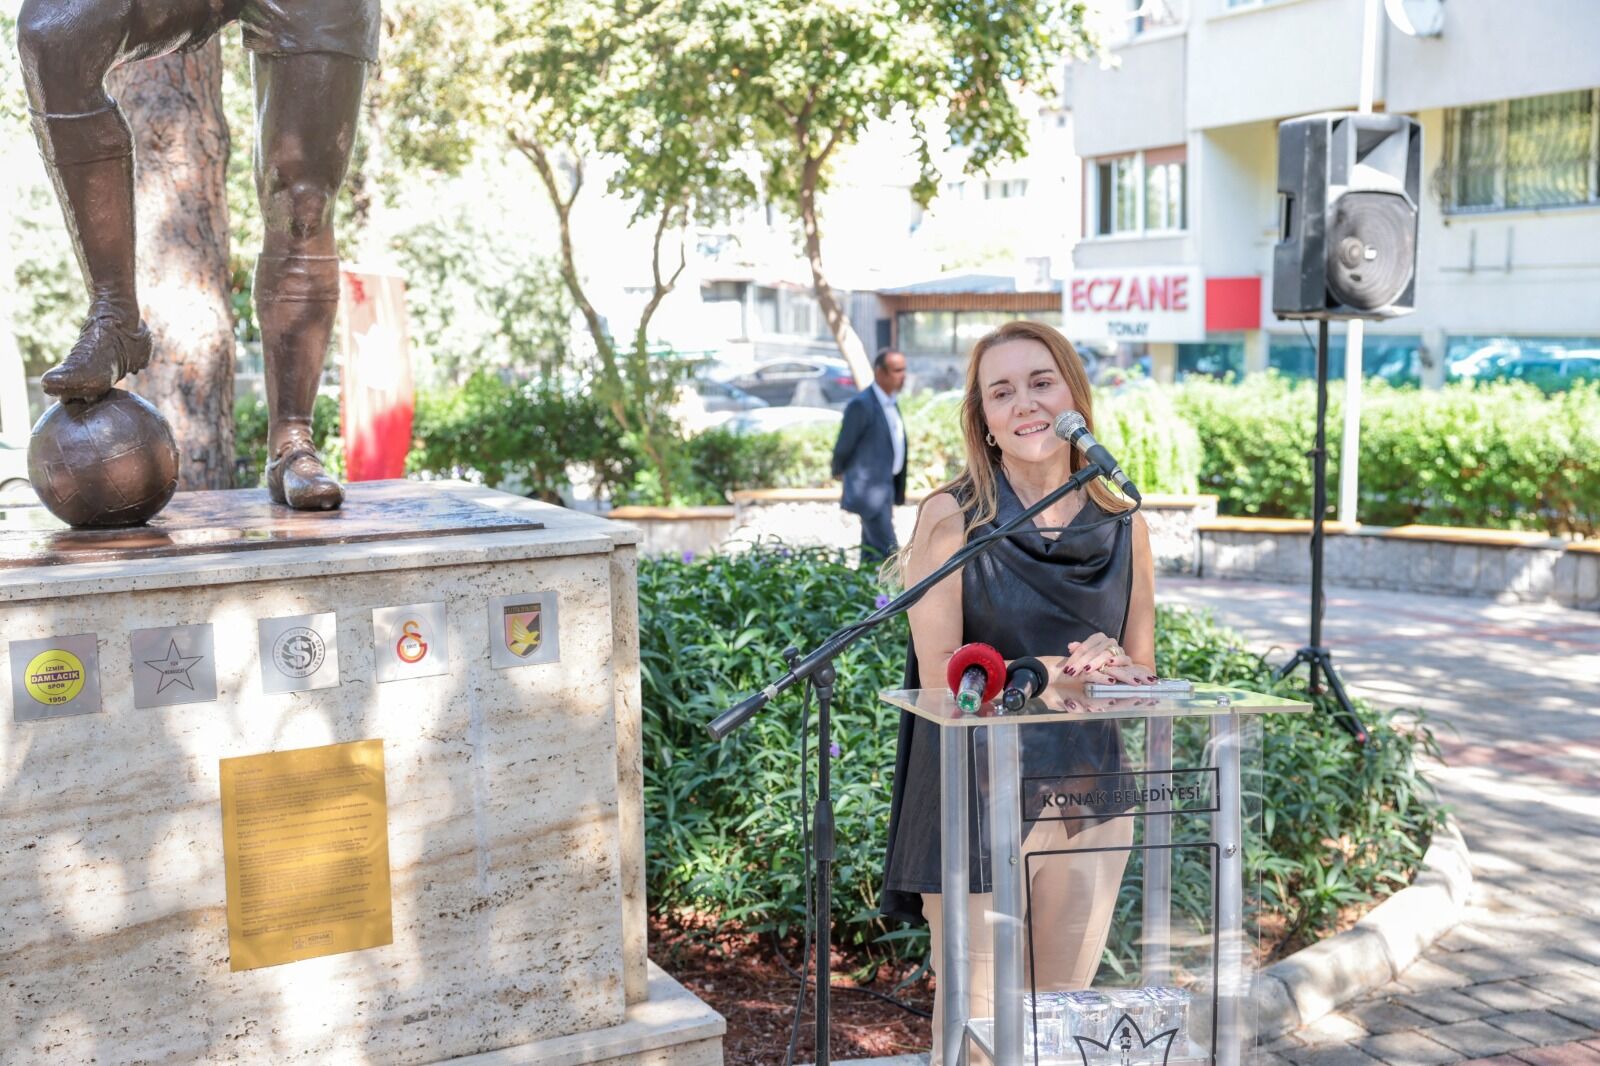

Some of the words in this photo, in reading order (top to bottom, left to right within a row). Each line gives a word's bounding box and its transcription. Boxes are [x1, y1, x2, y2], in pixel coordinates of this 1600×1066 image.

[1071, 275, 1188, 312] ECZANE
[31, 671, 79, 683] DAMLACIK
[48, 695, 67, 703] 1950
[1042, 791, 1106, 808] KONAK
[1113, 782, 1200, 804] BELEDİYESİ
